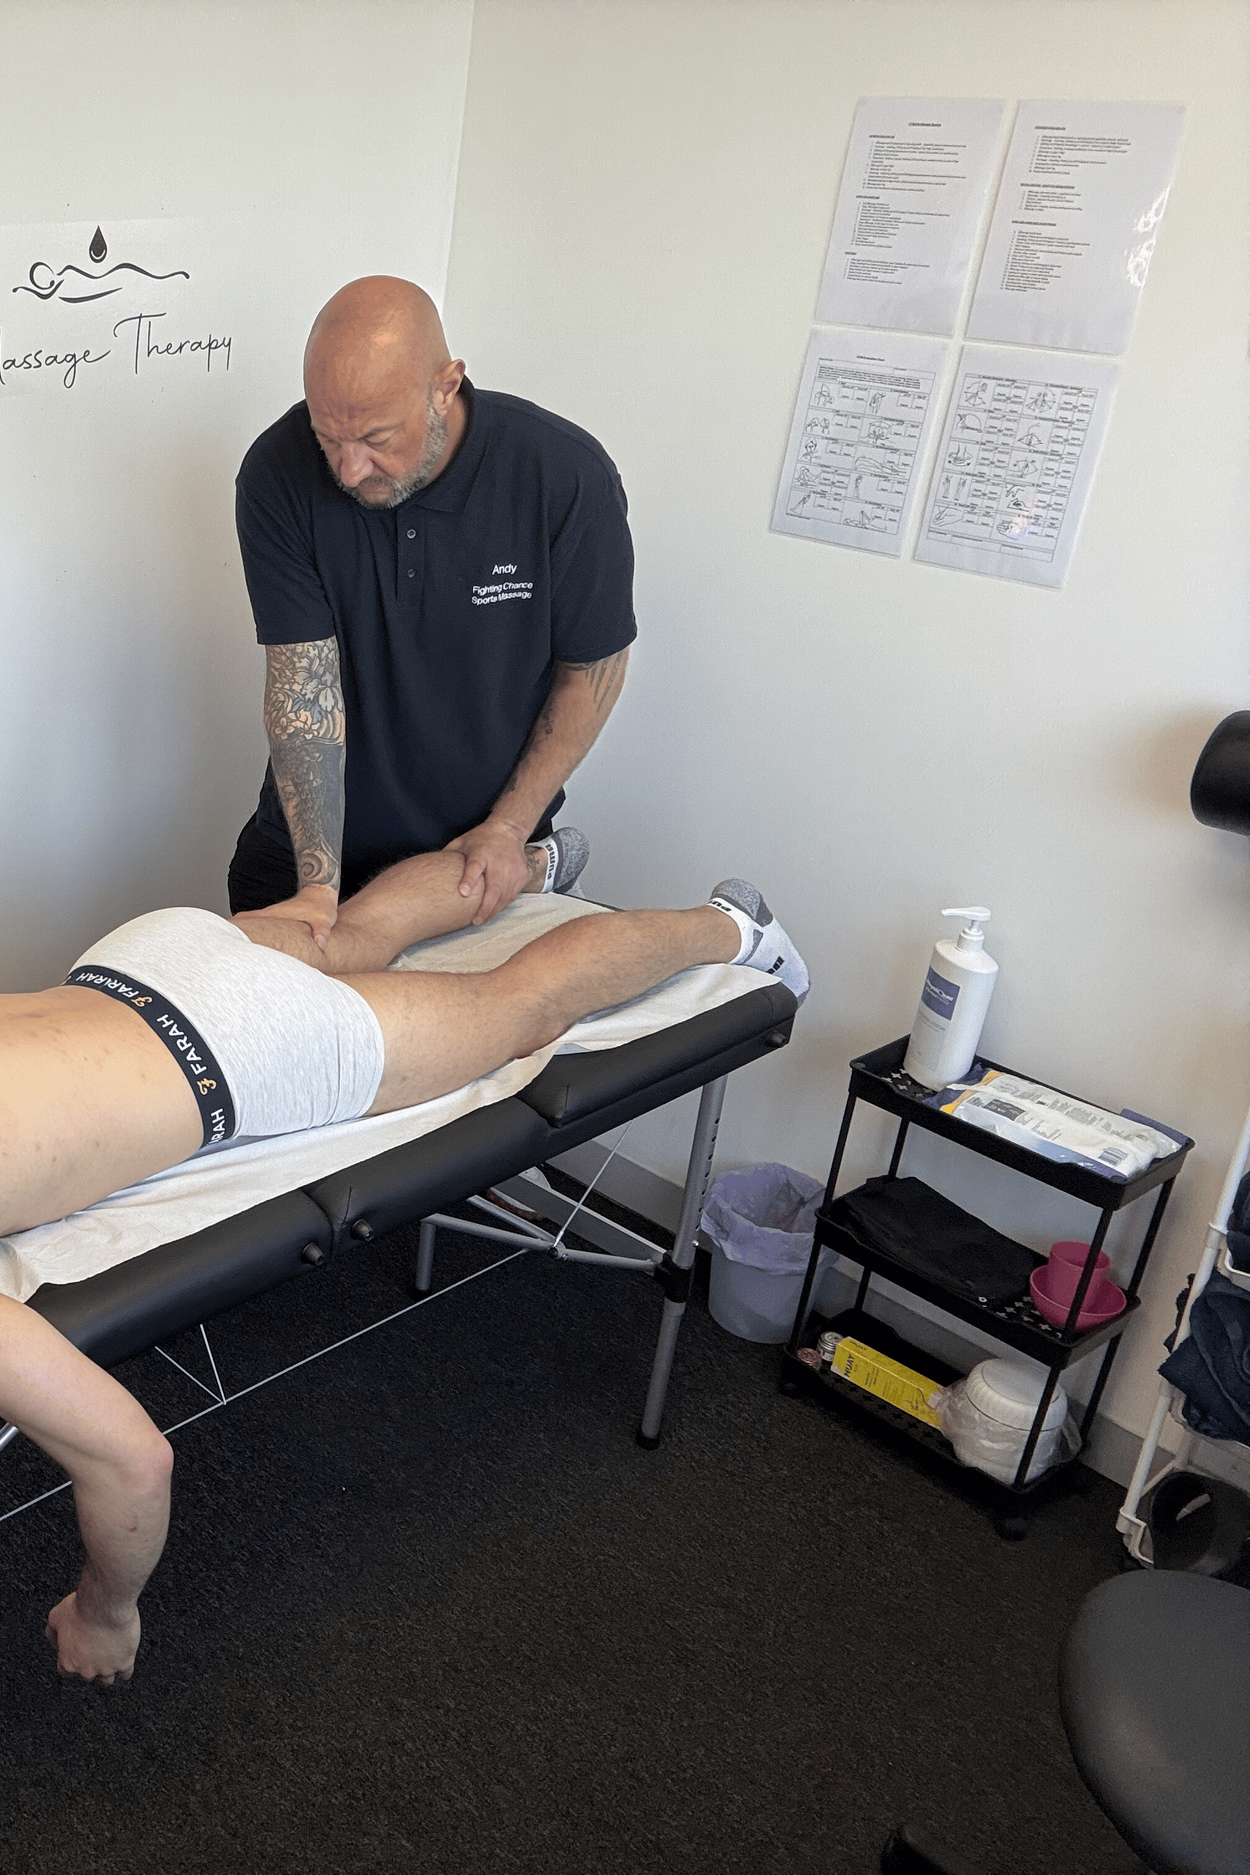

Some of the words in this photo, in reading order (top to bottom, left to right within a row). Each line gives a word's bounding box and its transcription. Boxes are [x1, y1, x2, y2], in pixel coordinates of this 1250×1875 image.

[113, 313, 231, 374] Therapy
[492, 563, 517, 575] Andy
[473, 584, 502, 596] Fighting
[503, 582, 533, 590] Chance
[472, 596, 497, 606] Sports
[498, 591, 532, 601] Massage
[157, 1014, 207, 1075] FARAH
